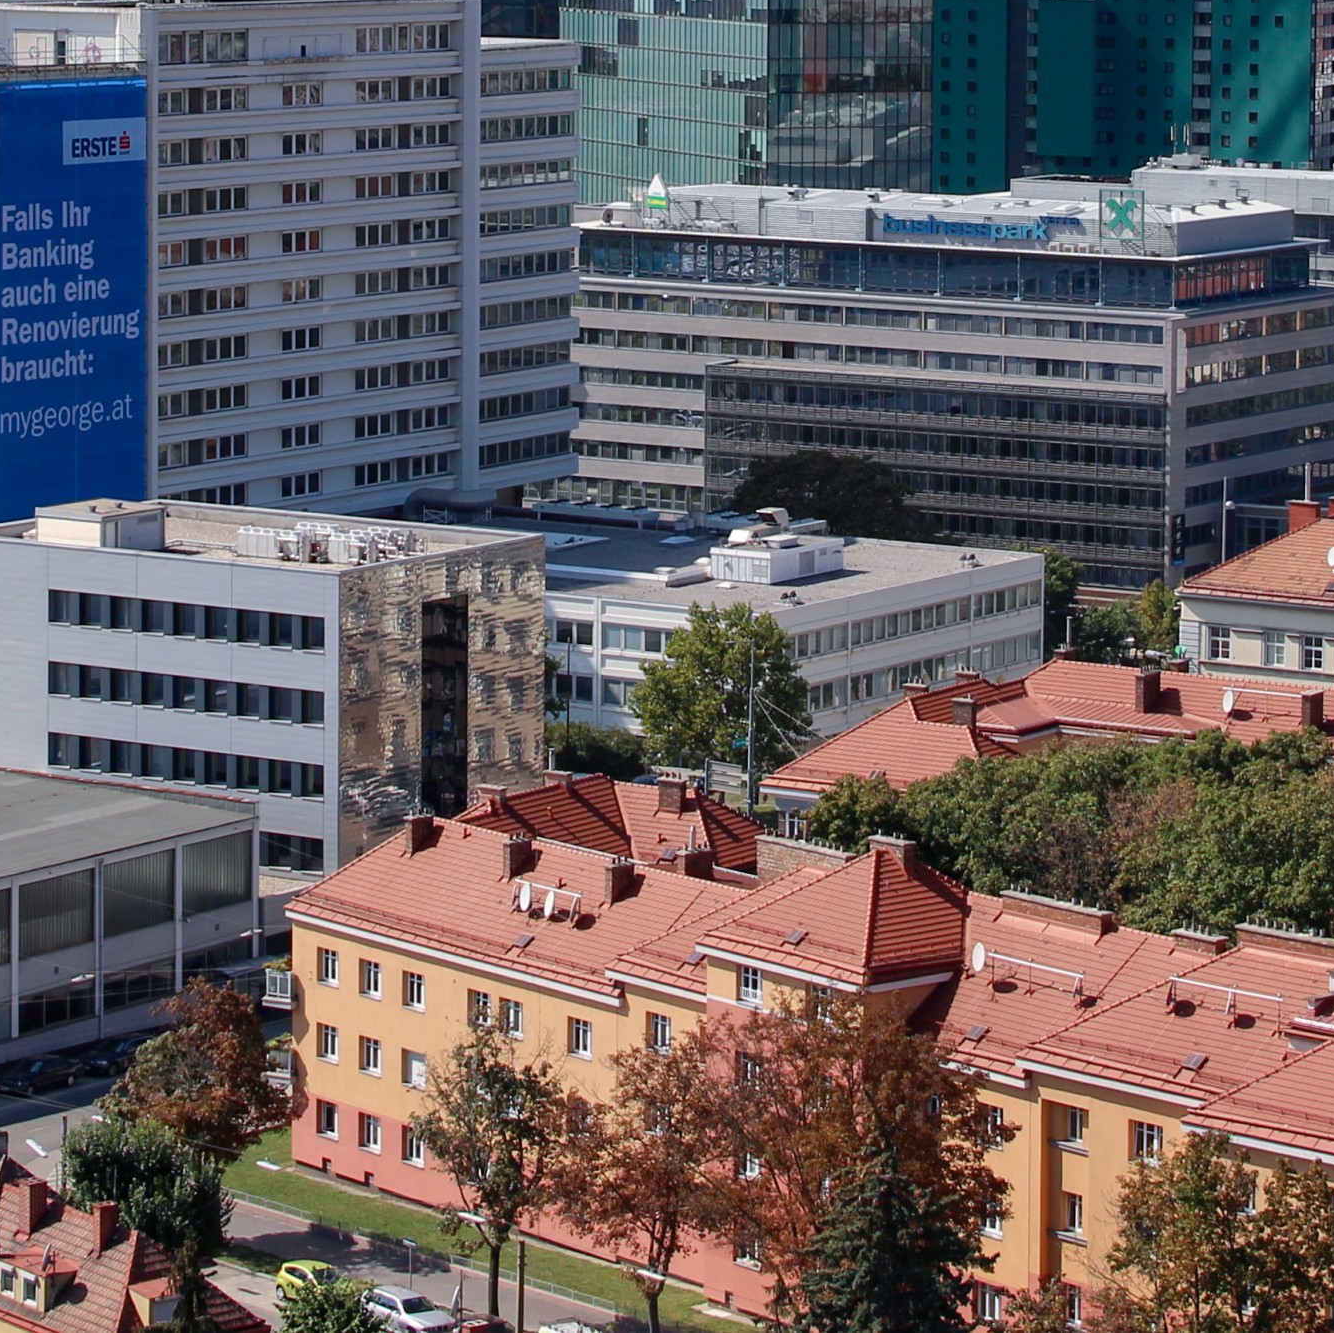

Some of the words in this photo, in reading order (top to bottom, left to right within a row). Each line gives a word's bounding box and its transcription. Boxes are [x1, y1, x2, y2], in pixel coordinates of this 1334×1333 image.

[71, 136, 117, 158] ERSTE
[2, 203, 54, 233] Falls
[62, 200, 91, 228] Ihr
[1, 238, 95, 270] Banking
[1, 277, 56, 308] auch
[63, 273, 110, 302] eine
[1, 309, 140, 346] Renovierung
[1, 349, 94, 384] braucht:
[0, 394, 133, 439] mygeorge.at
